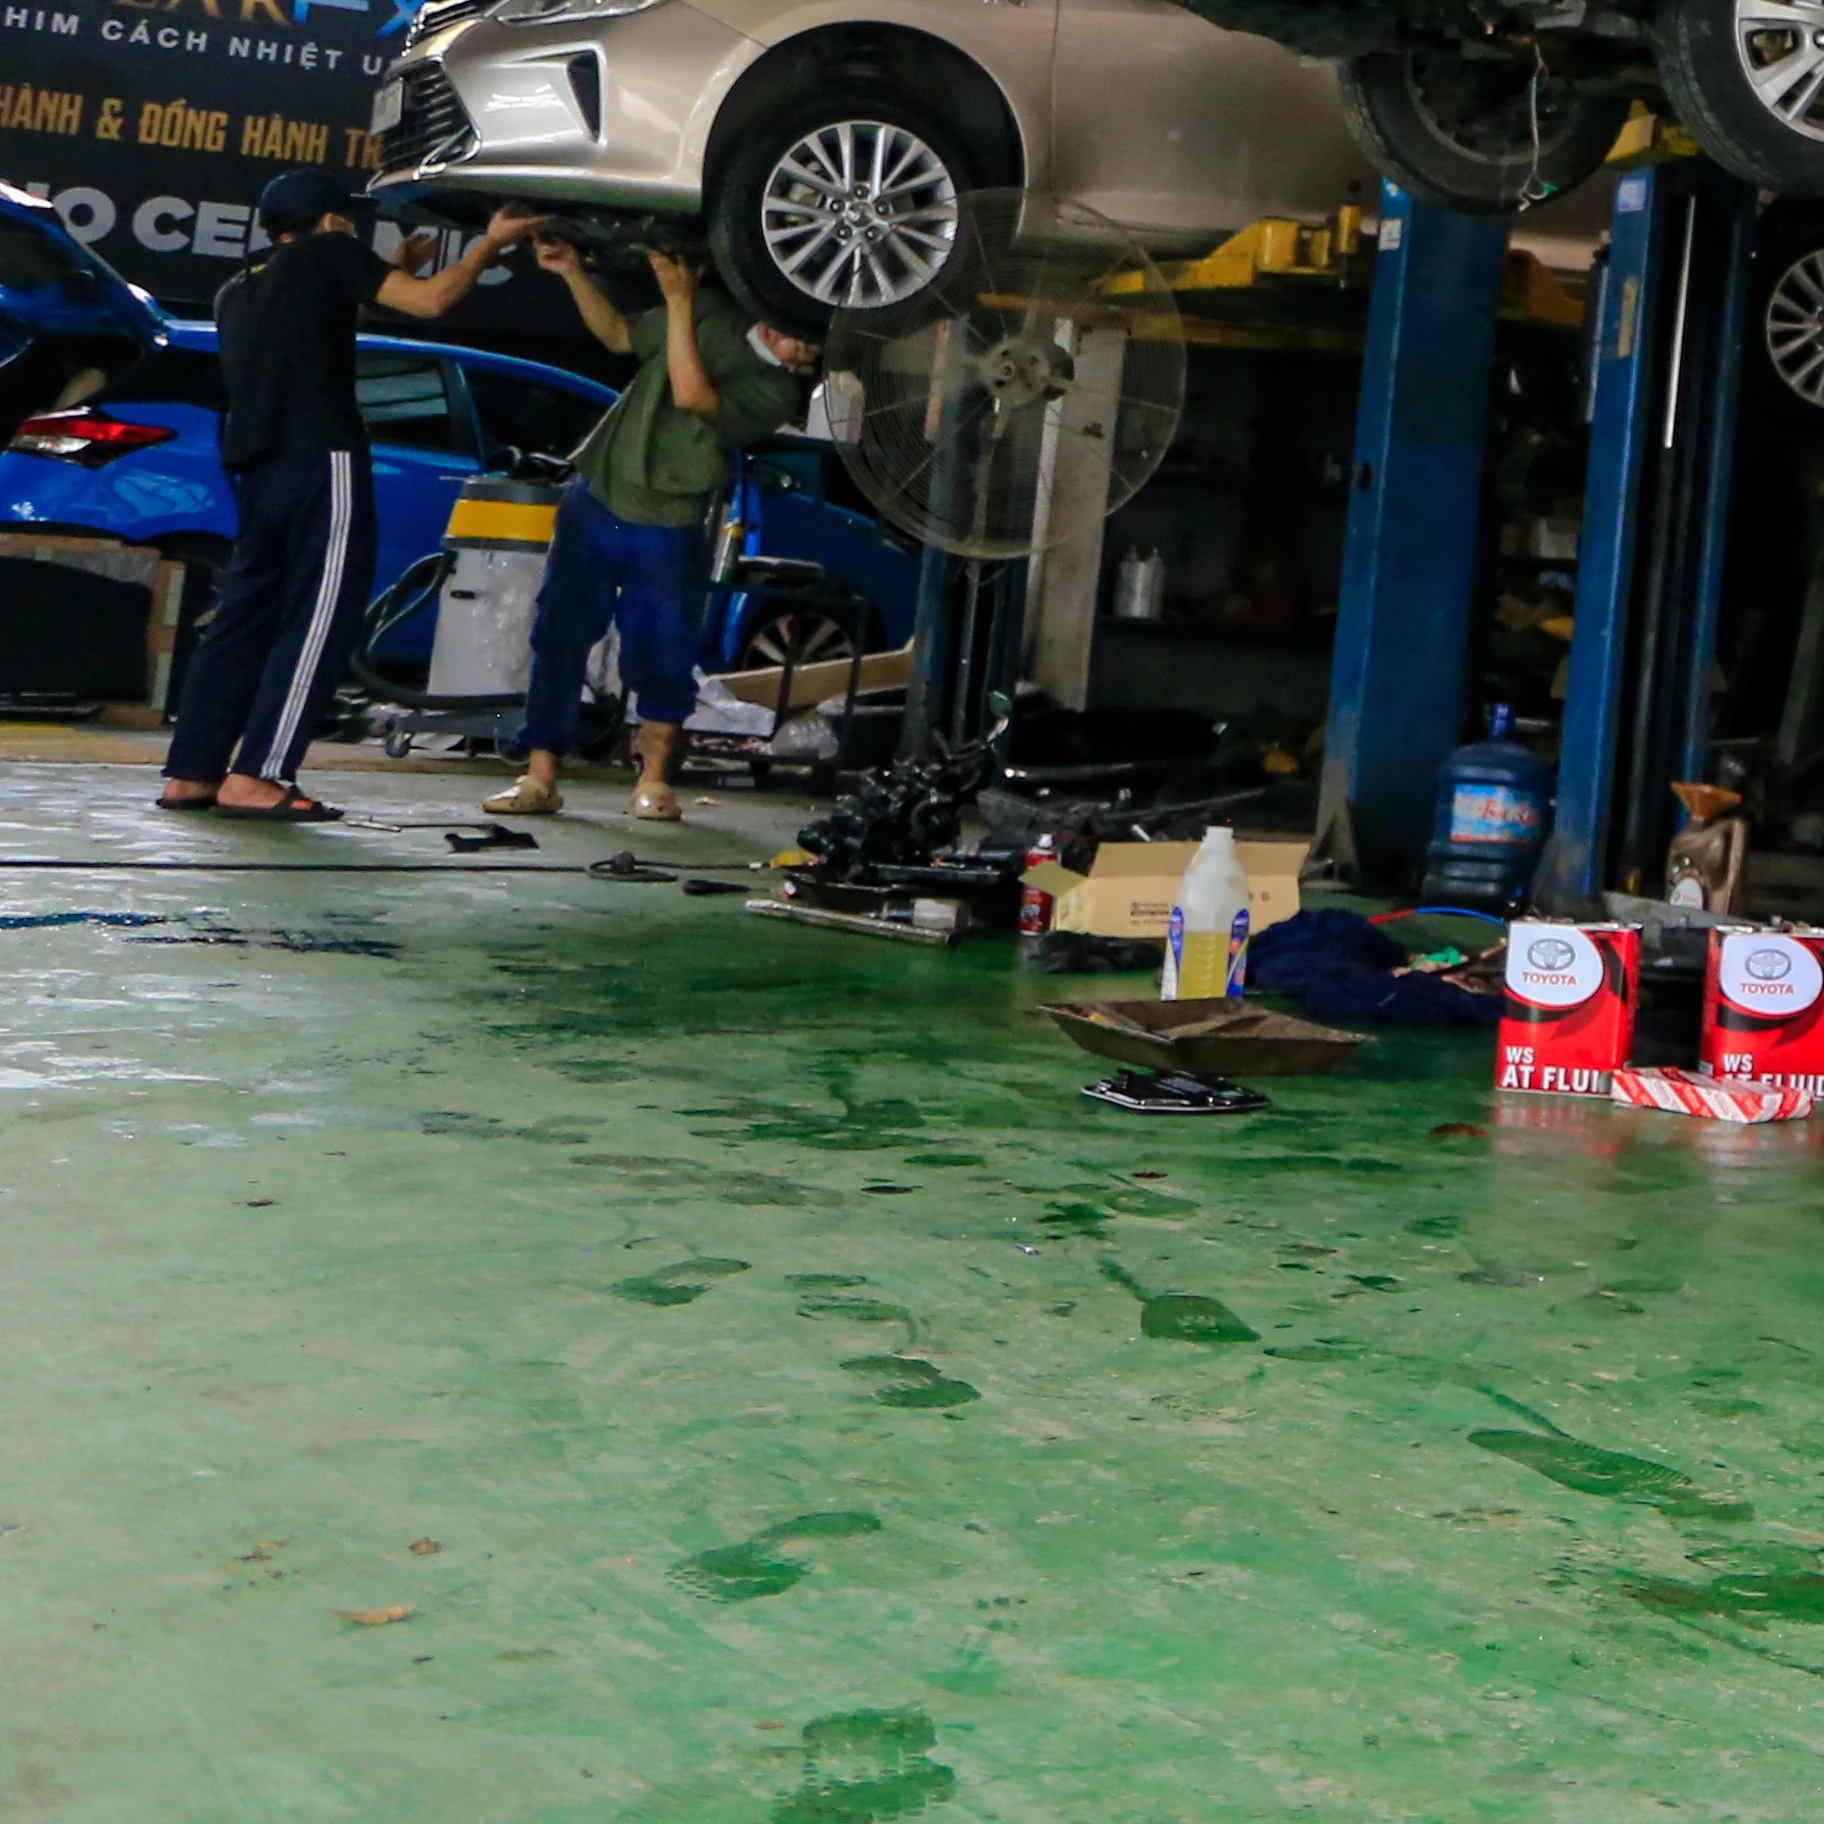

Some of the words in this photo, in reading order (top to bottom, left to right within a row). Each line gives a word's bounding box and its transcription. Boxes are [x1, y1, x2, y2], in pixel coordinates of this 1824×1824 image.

[101, 17, 209, 53] CÁCH
[228, 36, 344, 71] NHIỆT
[96, 97, 124, 141] &
[240, 112, 329, 165] HÀNH
[1522, 972, 1578, 987] TOYOTA
[1740, 982, 1795, 996] TOYOTA
[1505, 1045, 1535, 1064] WS
[1722, 1053, 1754, 1072] WS
[1501, 1065, 1536, 1089] AT
[1542, 1066, 1606, 1093] FLUI
